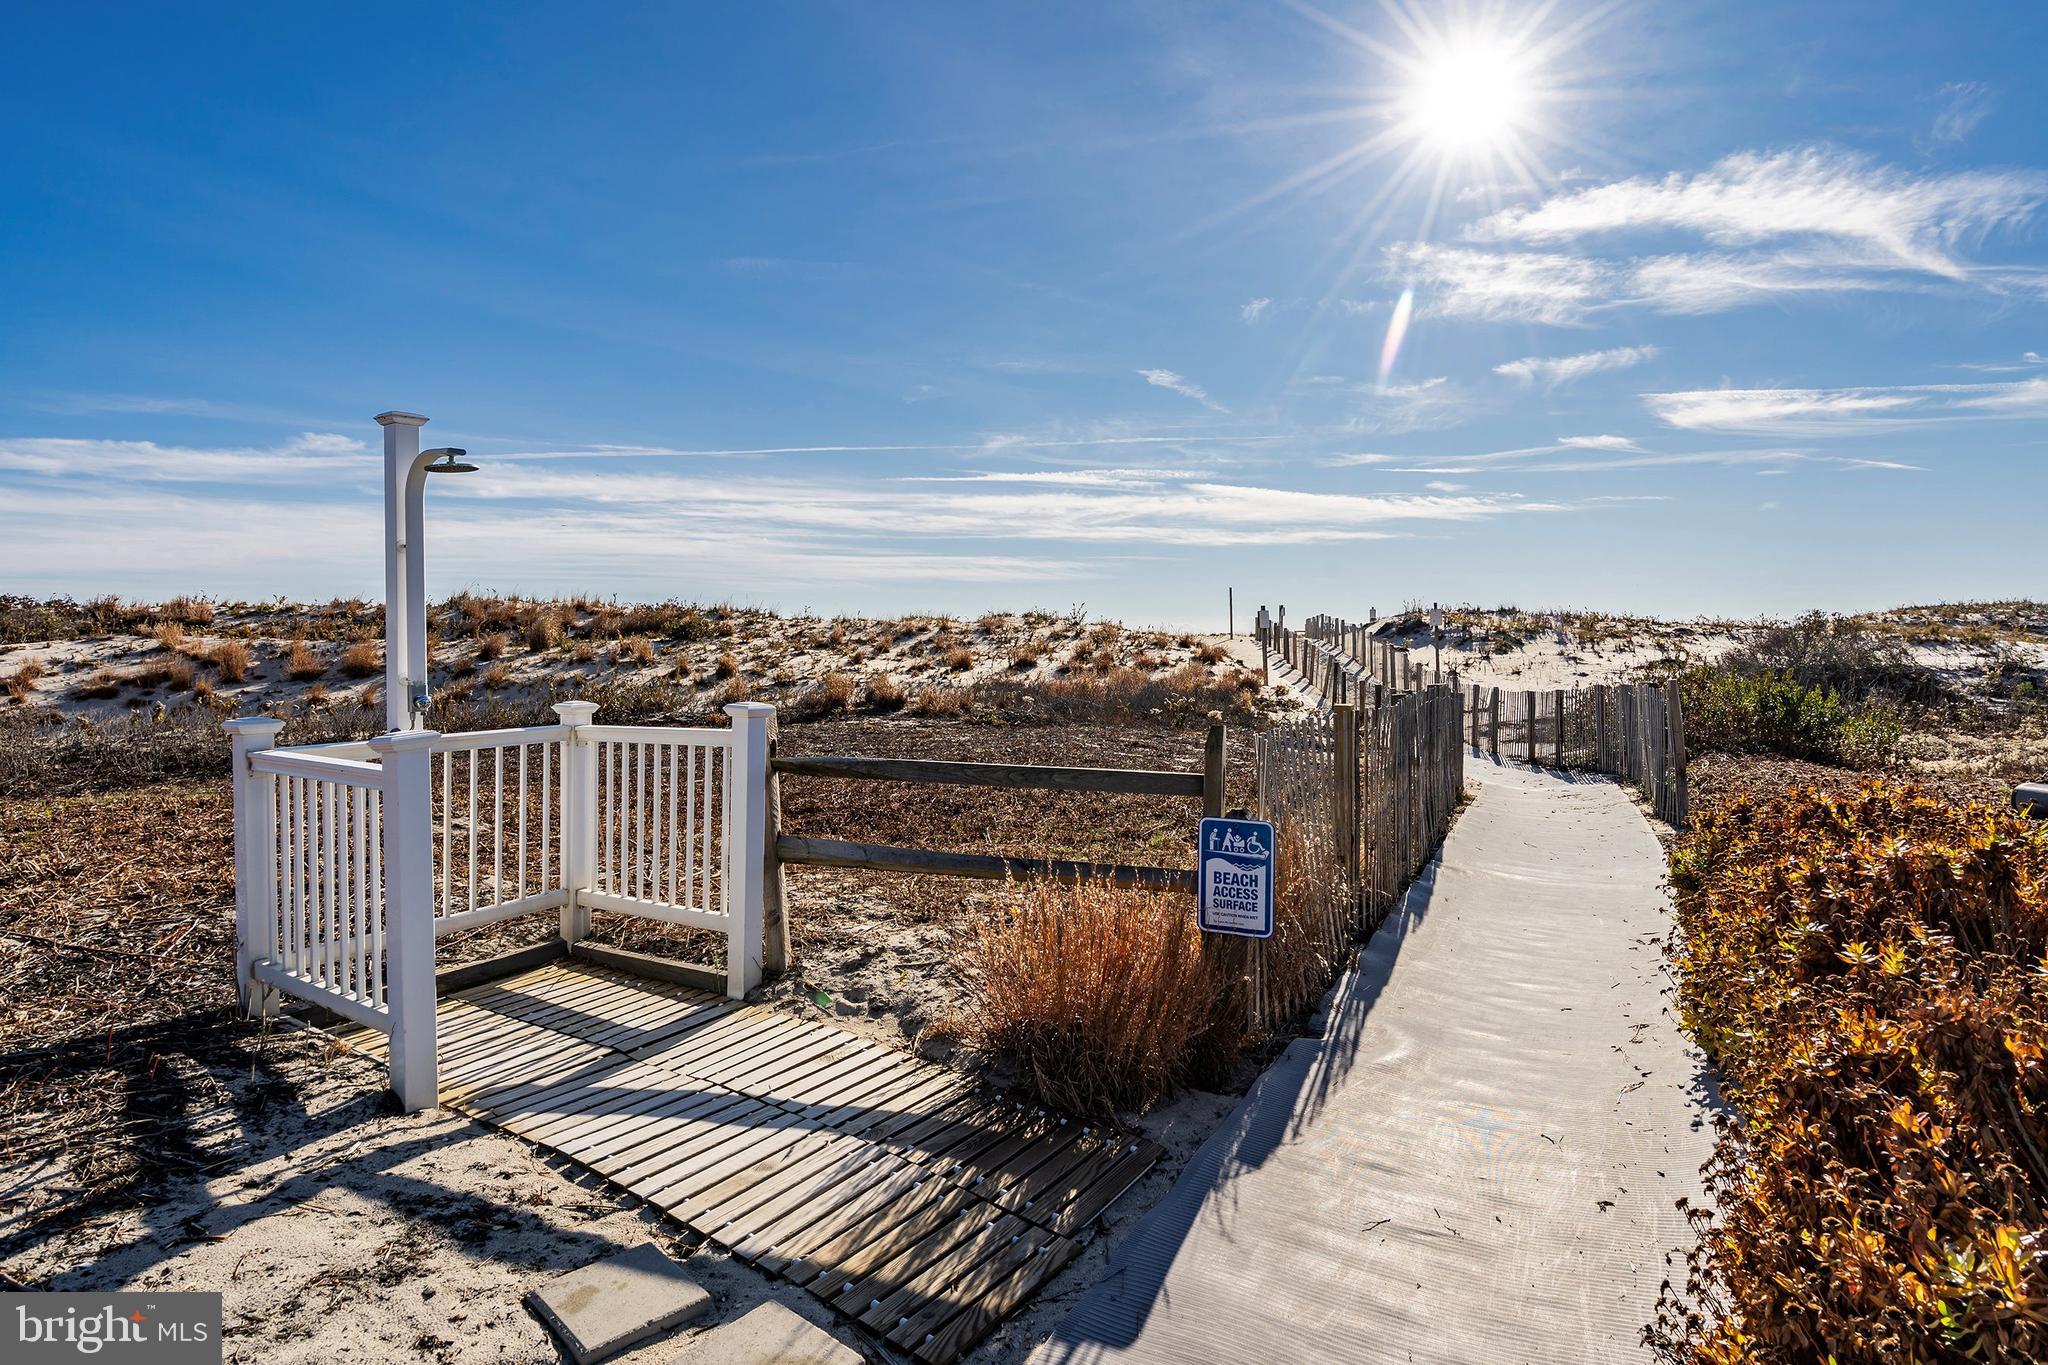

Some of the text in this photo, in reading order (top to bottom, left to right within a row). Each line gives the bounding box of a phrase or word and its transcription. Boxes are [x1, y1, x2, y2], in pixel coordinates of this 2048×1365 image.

[1213, 871, 1258, 888] BEACH
[1213, 886, 1258, 901] ACCESS
[1212, 898, 1258, 912] SURFACE
